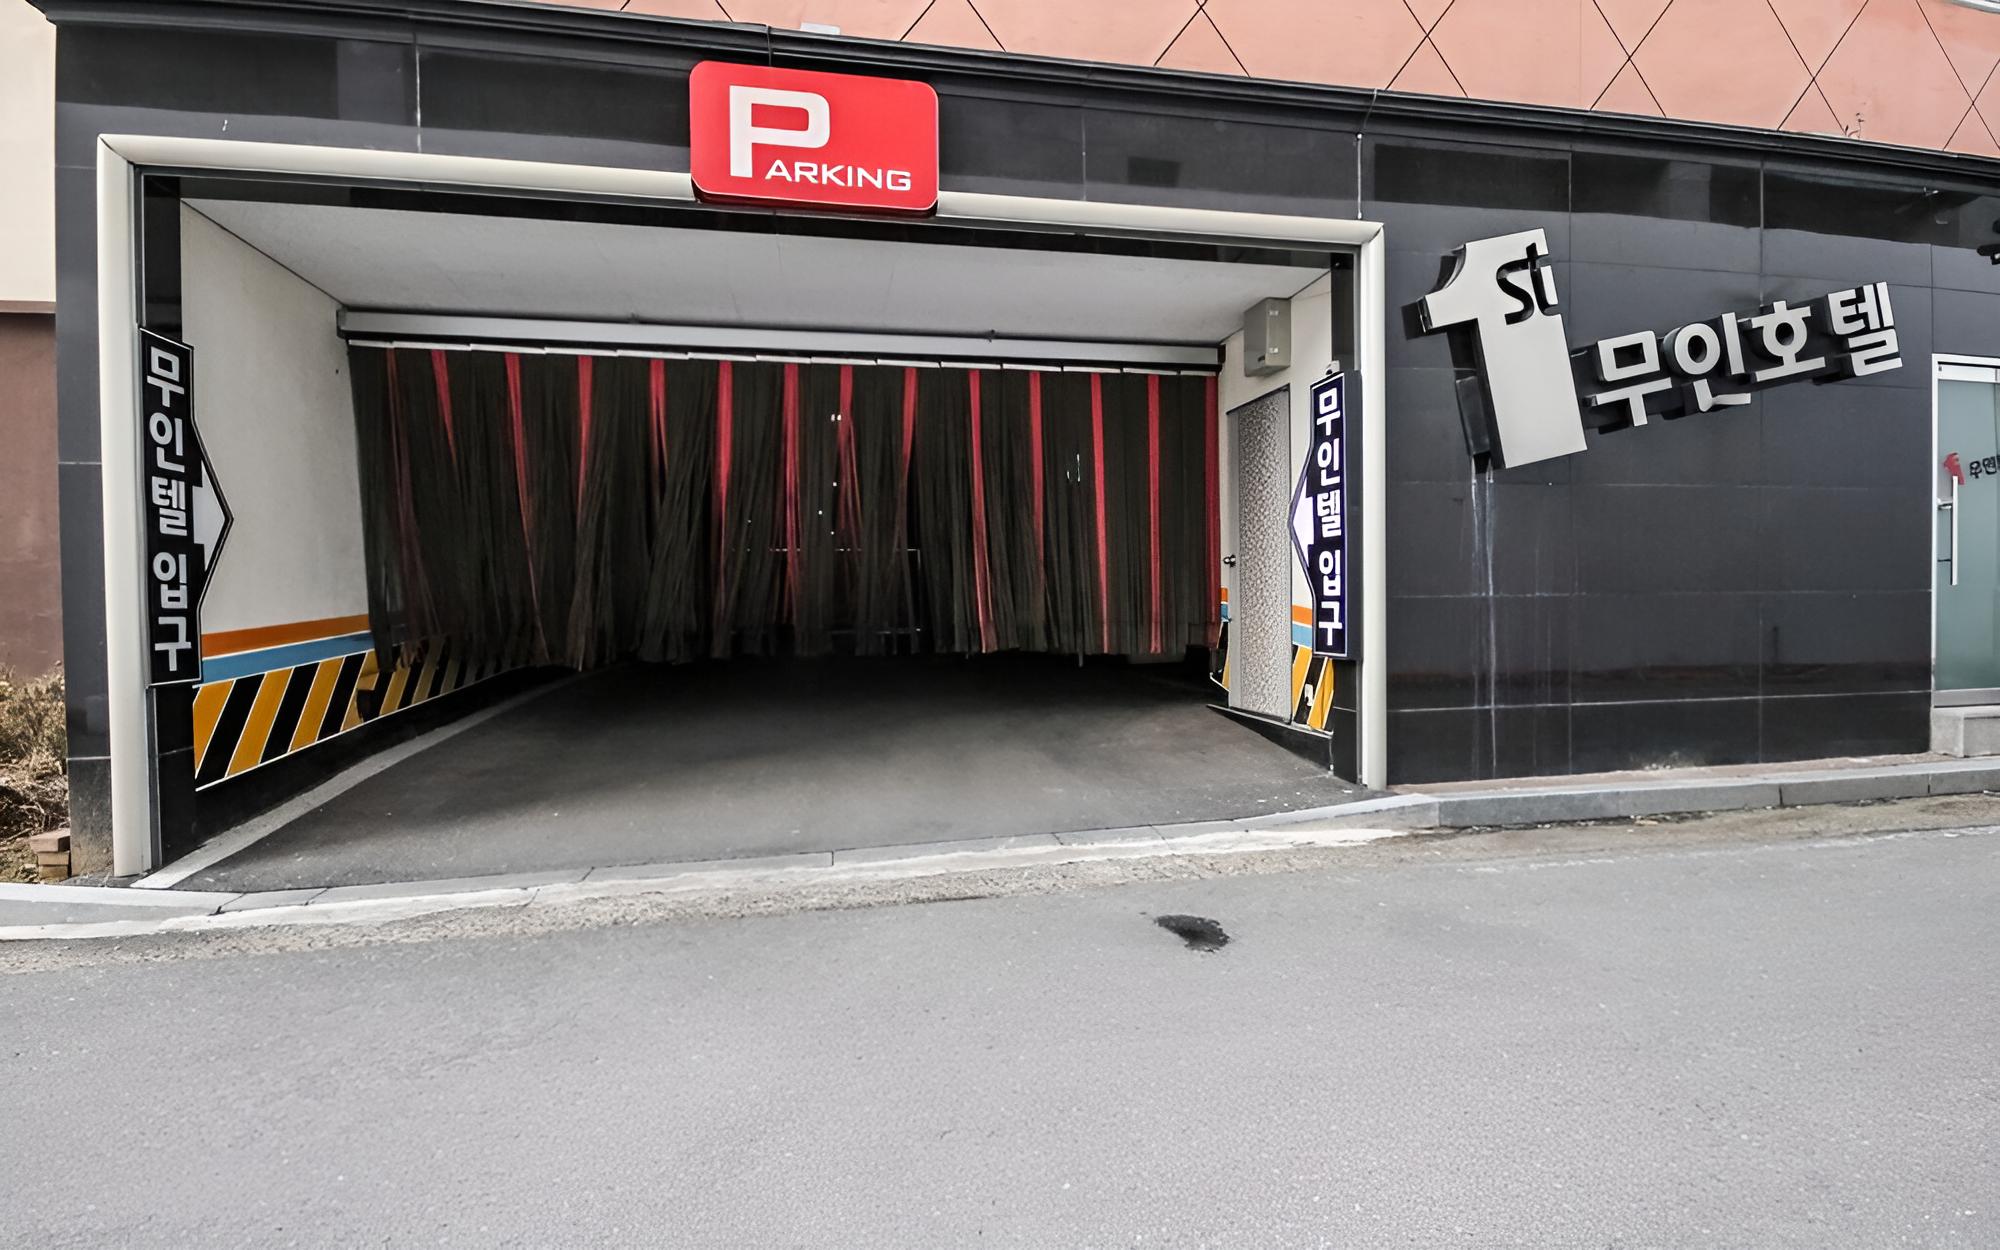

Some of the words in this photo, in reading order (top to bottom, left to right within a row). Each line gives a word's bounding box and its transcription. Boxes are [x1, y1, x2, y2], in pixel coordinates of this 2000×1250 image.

[728, 84, 911, 191] PARKING
[1596, 281, 1903, 427] 무인호텔
[146, 345, 188, 537] 무인텔
[1316, 387, 1342, 538] 무인텔
[153, 551, 192, 673] 입구
[1318, 549, 1343, 647] 입구
